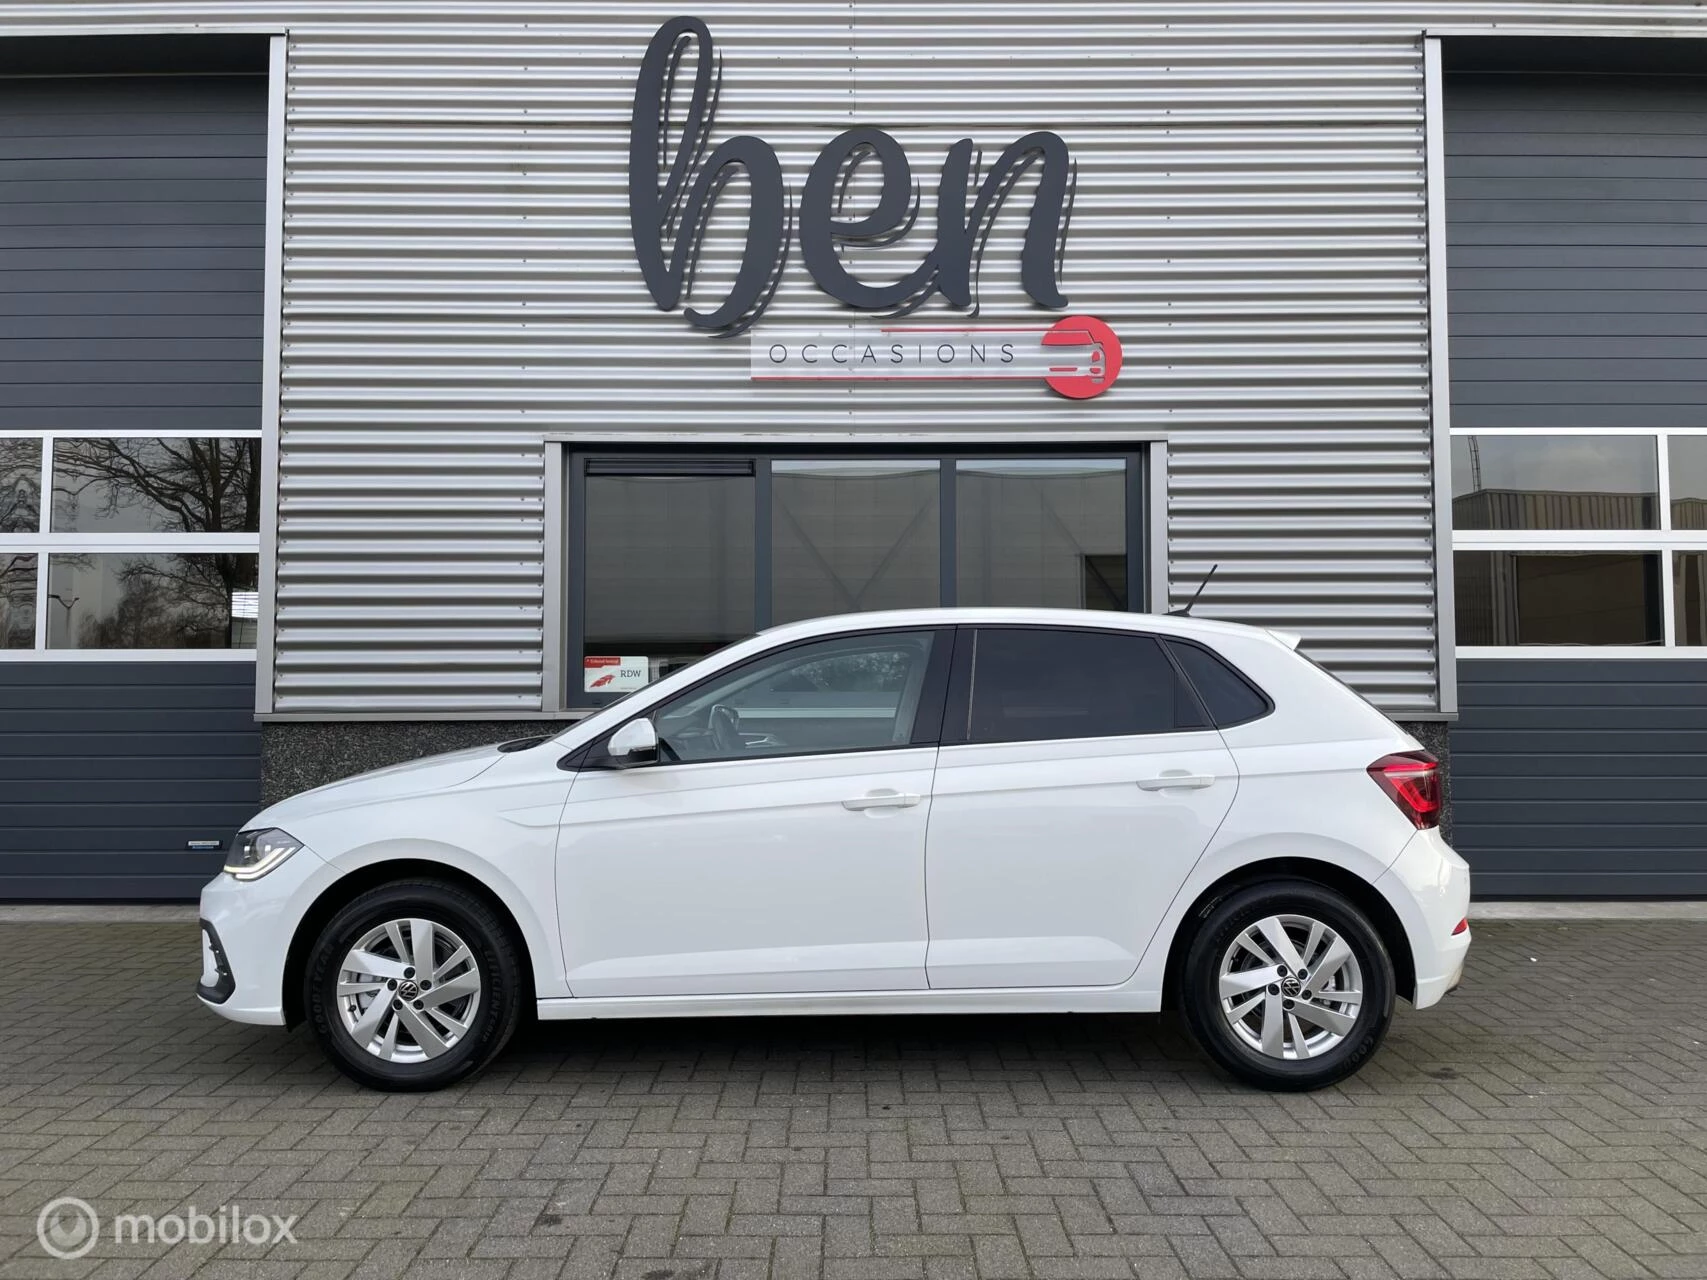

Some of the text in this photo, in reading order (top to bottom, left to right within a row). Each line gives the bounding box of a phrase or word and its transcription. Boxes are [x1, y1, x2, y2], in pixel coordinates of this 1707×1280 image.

[629, 15, 1069, 329] ben
[768, 343, 1014, 364] OCCASIONS
[620, 669, 641, 678] RDW
